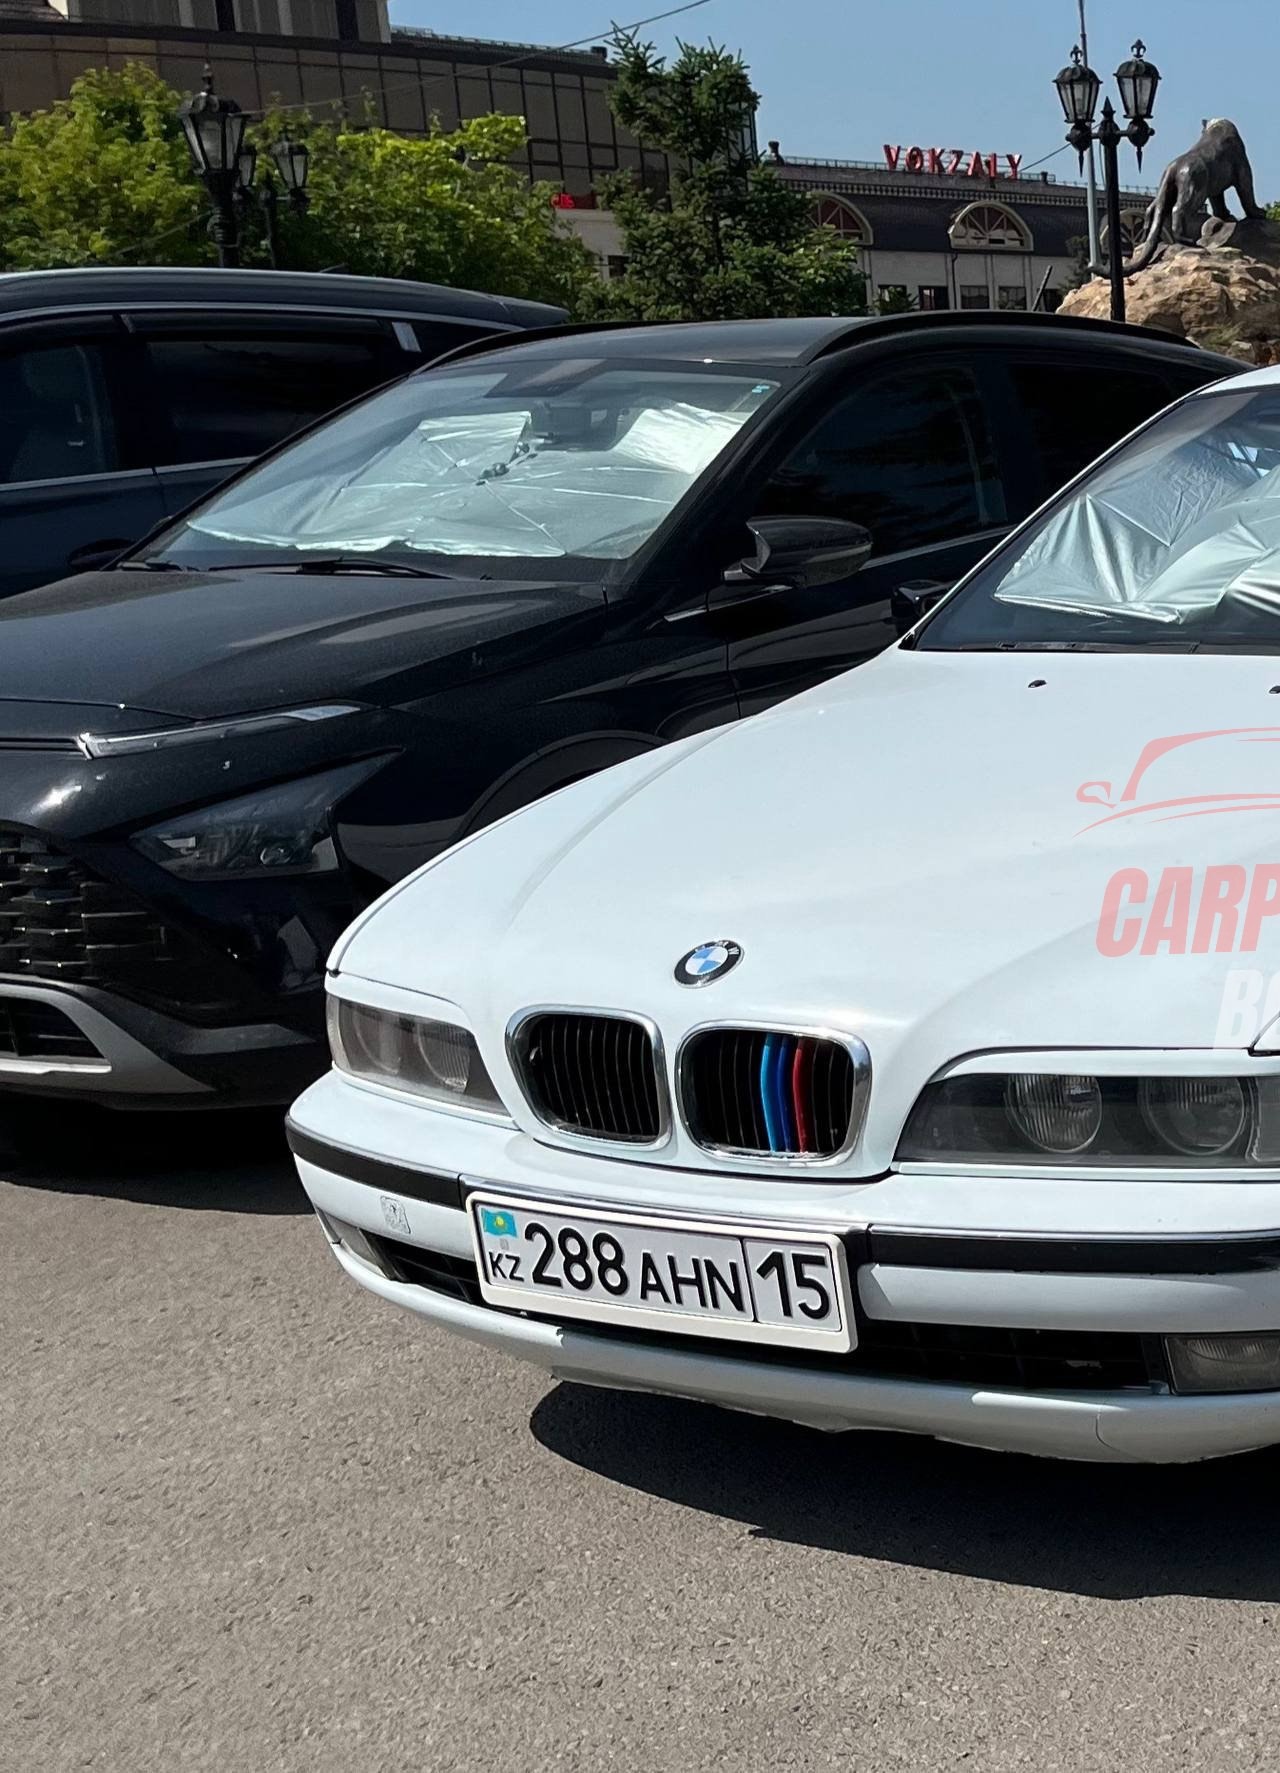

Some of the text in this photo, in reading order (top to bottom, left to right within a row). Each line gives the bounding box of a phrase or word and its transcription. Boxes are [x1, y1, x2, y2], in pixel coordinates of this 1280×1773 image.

[883, 144, 1022, 180] VOKZALY
[488, 1222, 831, 1320] KZ 288 AHN 15
